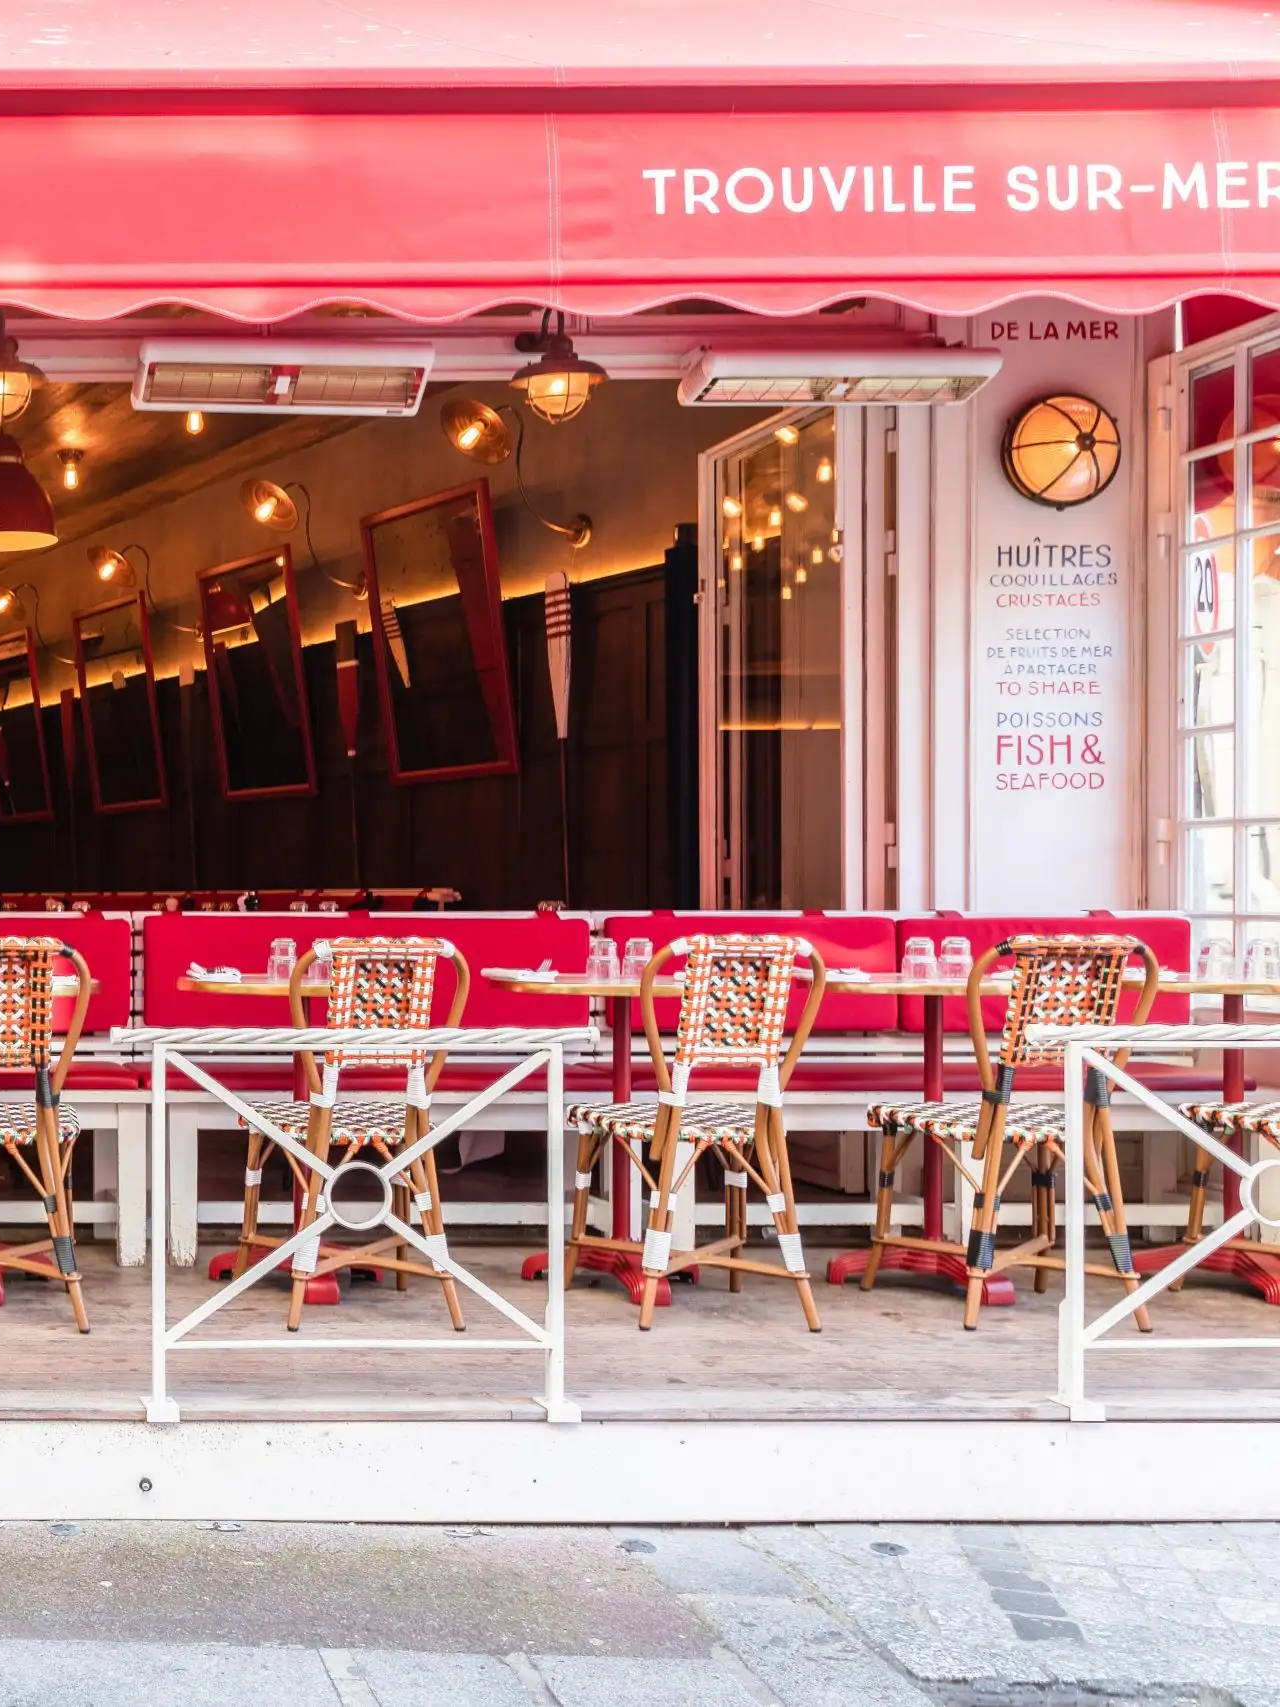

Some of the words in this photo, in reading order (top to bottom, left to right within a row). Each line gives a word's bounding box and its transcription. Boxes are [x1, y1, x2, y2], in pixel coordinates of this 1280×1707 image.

[642, 165, 976, 214] TROUVILLE
[1006, 161, 1280, 212] SUR-MER
[991, 321, 1019, 341] DE
[1029, 321, 1059, 340] LA
[1066, 320, 1120, 340] MER
[997, 536, 1112, 569] HUÎTRES
[989, 571, 1118, 588] COQUILLAGES
[1195, 556, 1214, 613] 20
[996, 591, 1101, 608] CRUSTACÉS
[1005, 628, 1091, 642] SELECTION
[987, 646, 1006, 659] DE
[1010, 646, 1058, 658] FRUITS
[1062, 646, 1077, 658] DE
[1081, 645, 1113, 658] MER
[1017, 663, 1097, 675] PARTAGER
[996, 681, 1021, 696] TO
[1028, 681, 1102, 696] SHARE
[996, 711, 1104, 728] POISSONS
[996, 734, 1072, 765] FISH
[1080, 733, 1106, 765] &
[995, 772, 1105, 791] SEAFOOD
